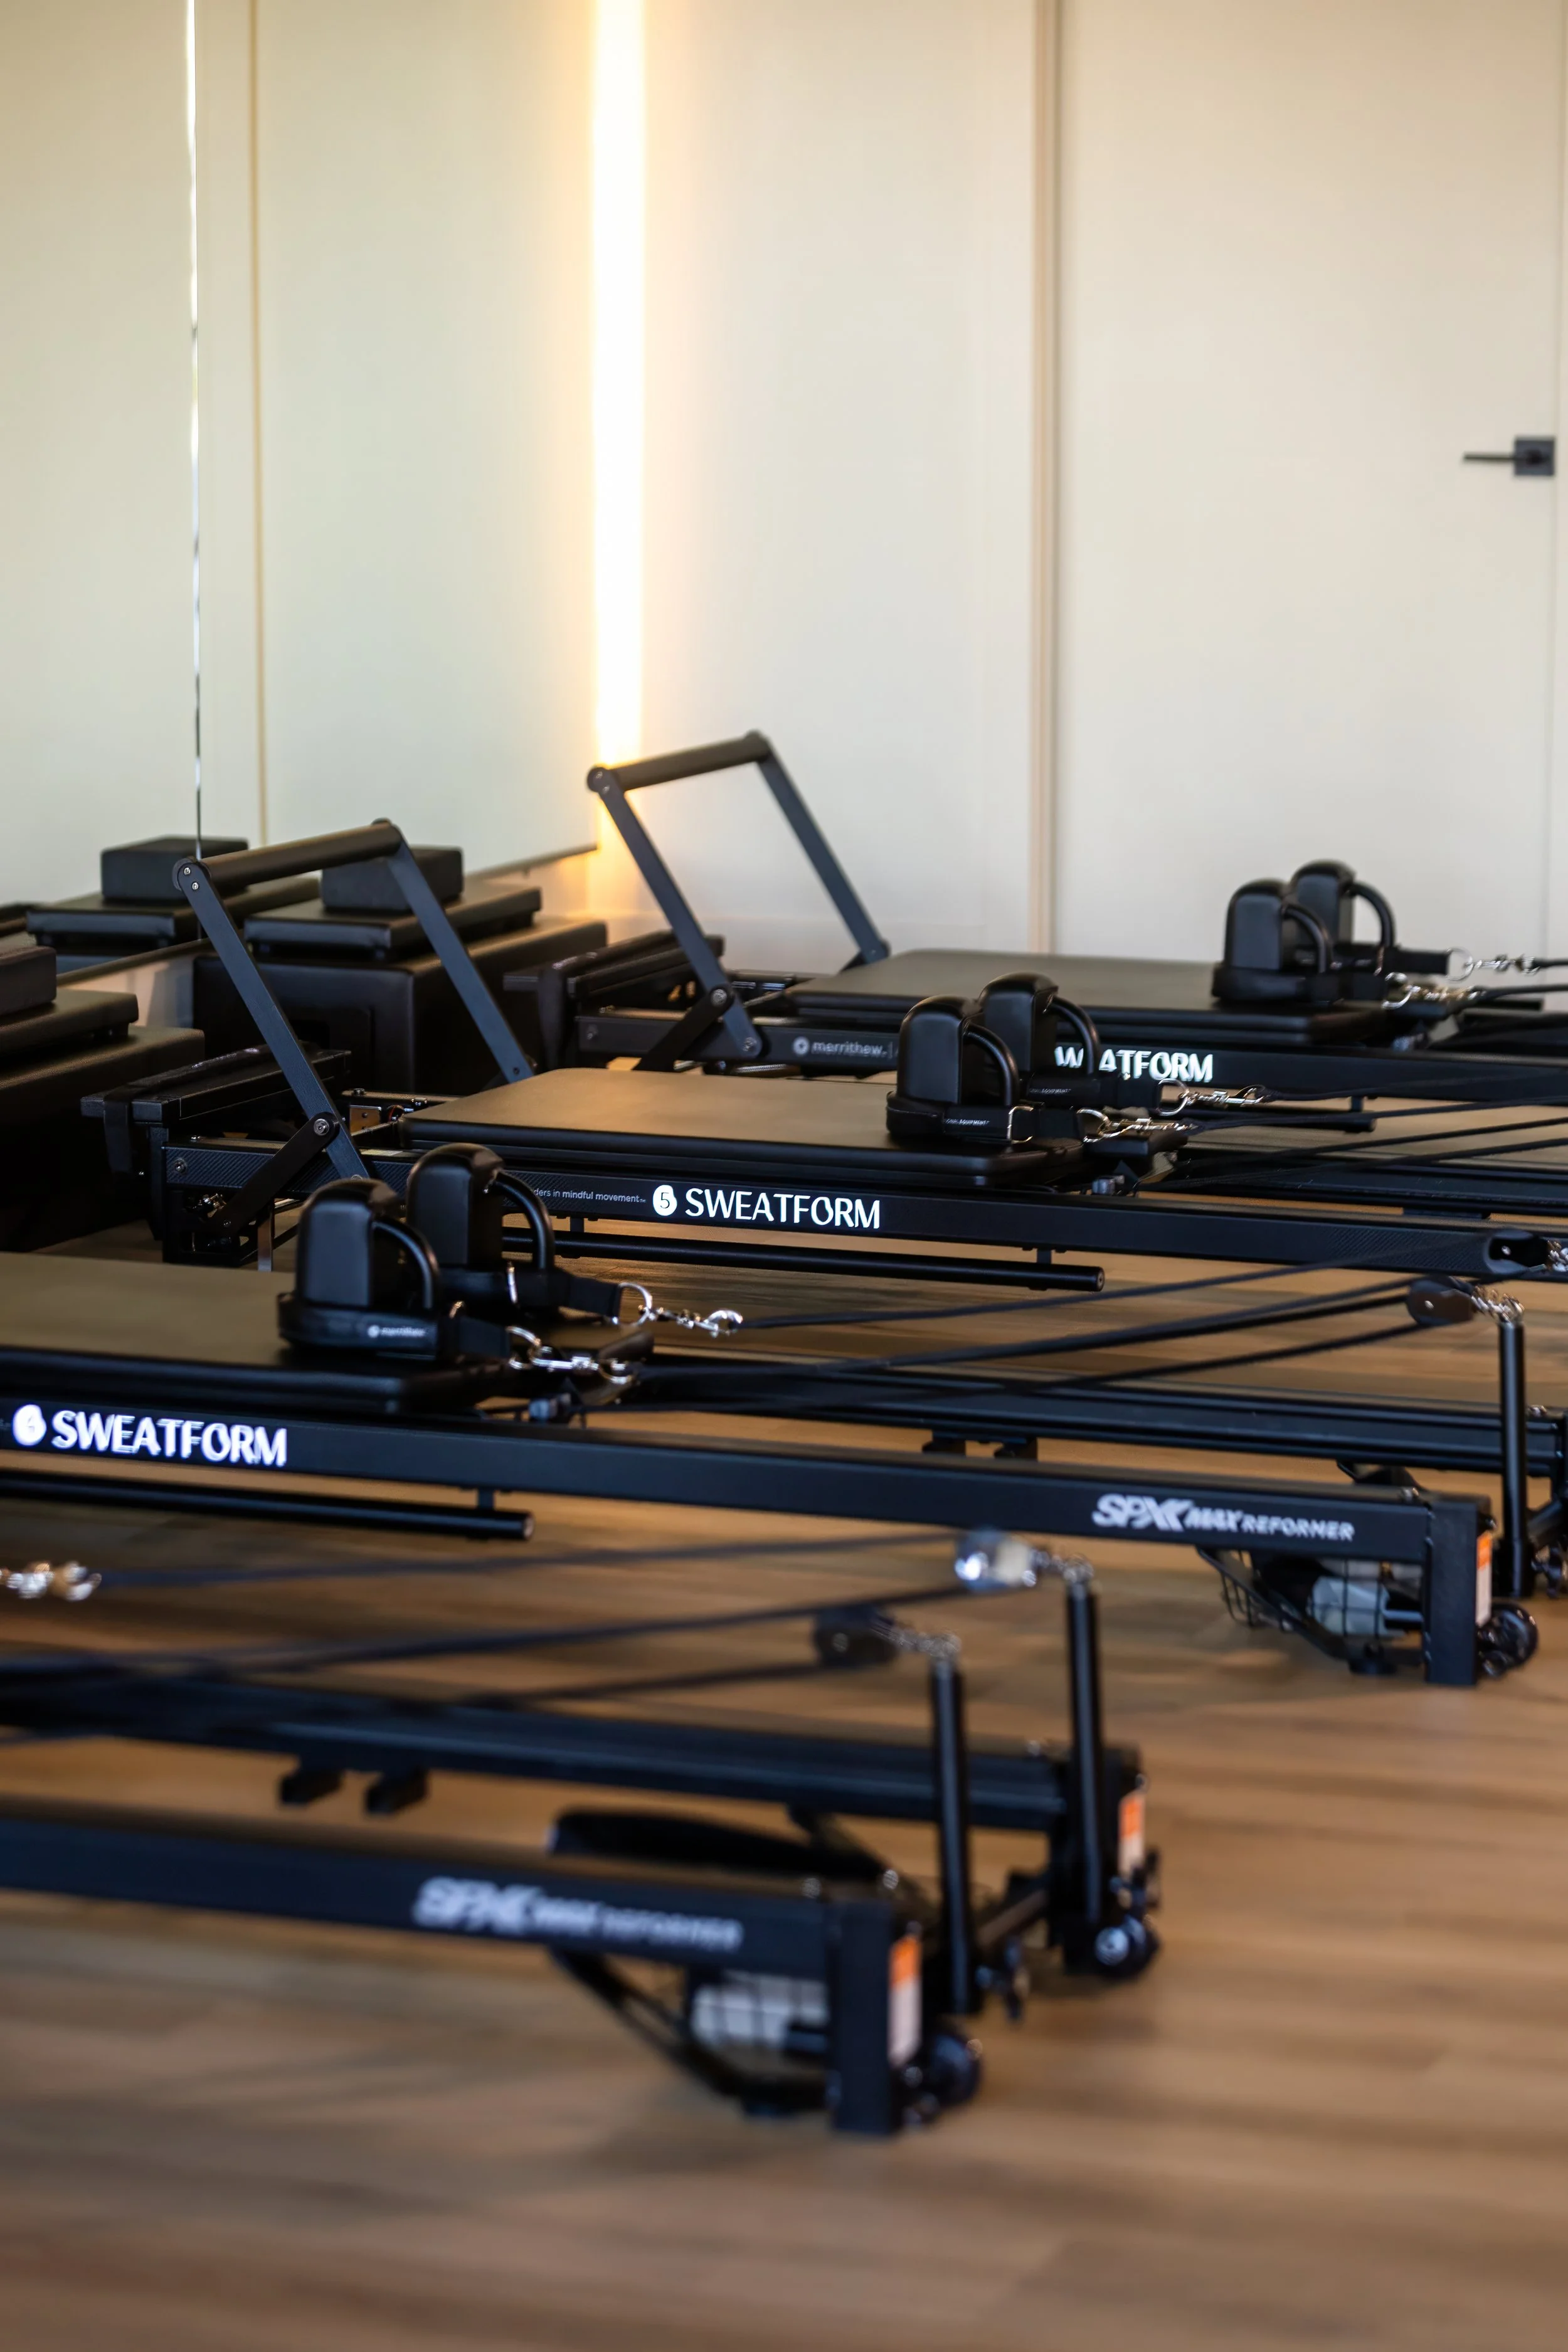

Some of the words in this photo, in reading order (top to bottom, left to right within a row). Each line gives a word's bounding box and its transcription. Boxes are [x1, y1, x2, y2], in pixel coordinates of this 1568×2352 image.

[1054, 1046, 1213, 1083] WATFORM
[533, 1187, 551, 1197] ders
[553, 1189, 560, 1197] in
[563, 1190, 593, 1200] mindful
[685, 1187, 880, 1229] SWEATFORM
[51, 1410, 287, 1467] SWEATFORM
[1240, 1513, 1355, 1541] REFORMER
